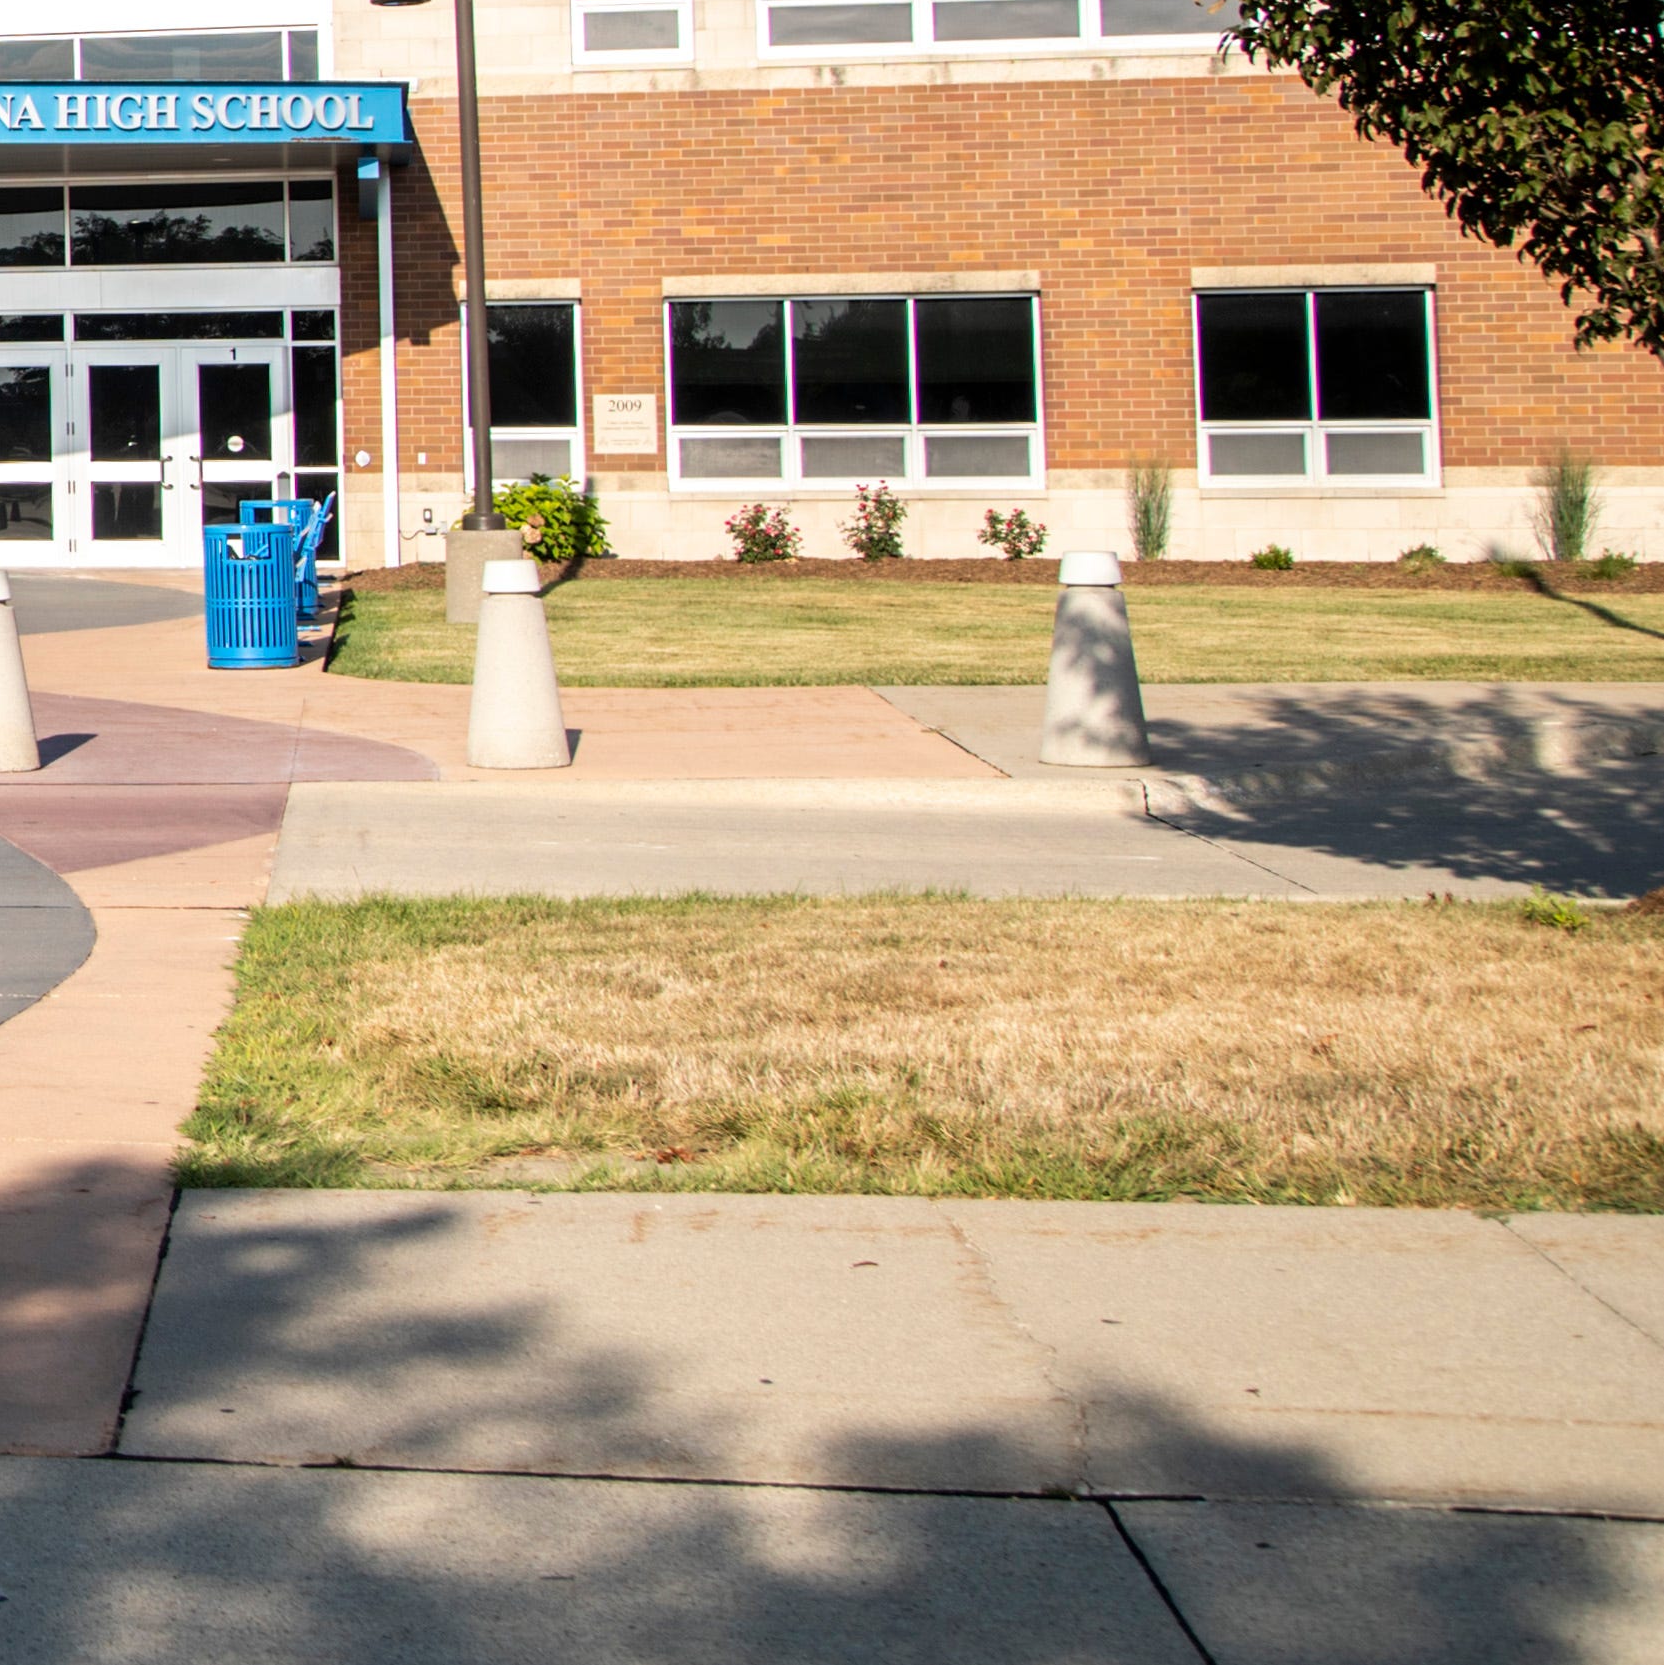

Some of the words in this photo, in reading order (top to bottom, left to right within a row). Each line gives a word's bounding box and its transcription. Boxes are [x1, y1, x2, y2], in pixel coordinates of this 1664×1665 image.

[54, 93, 180, 131] HIGH
[191, 93, 374, 132] SCHOOL
[229, 347, 236, 361] 1
[608, 399, 642, 413] 2009
